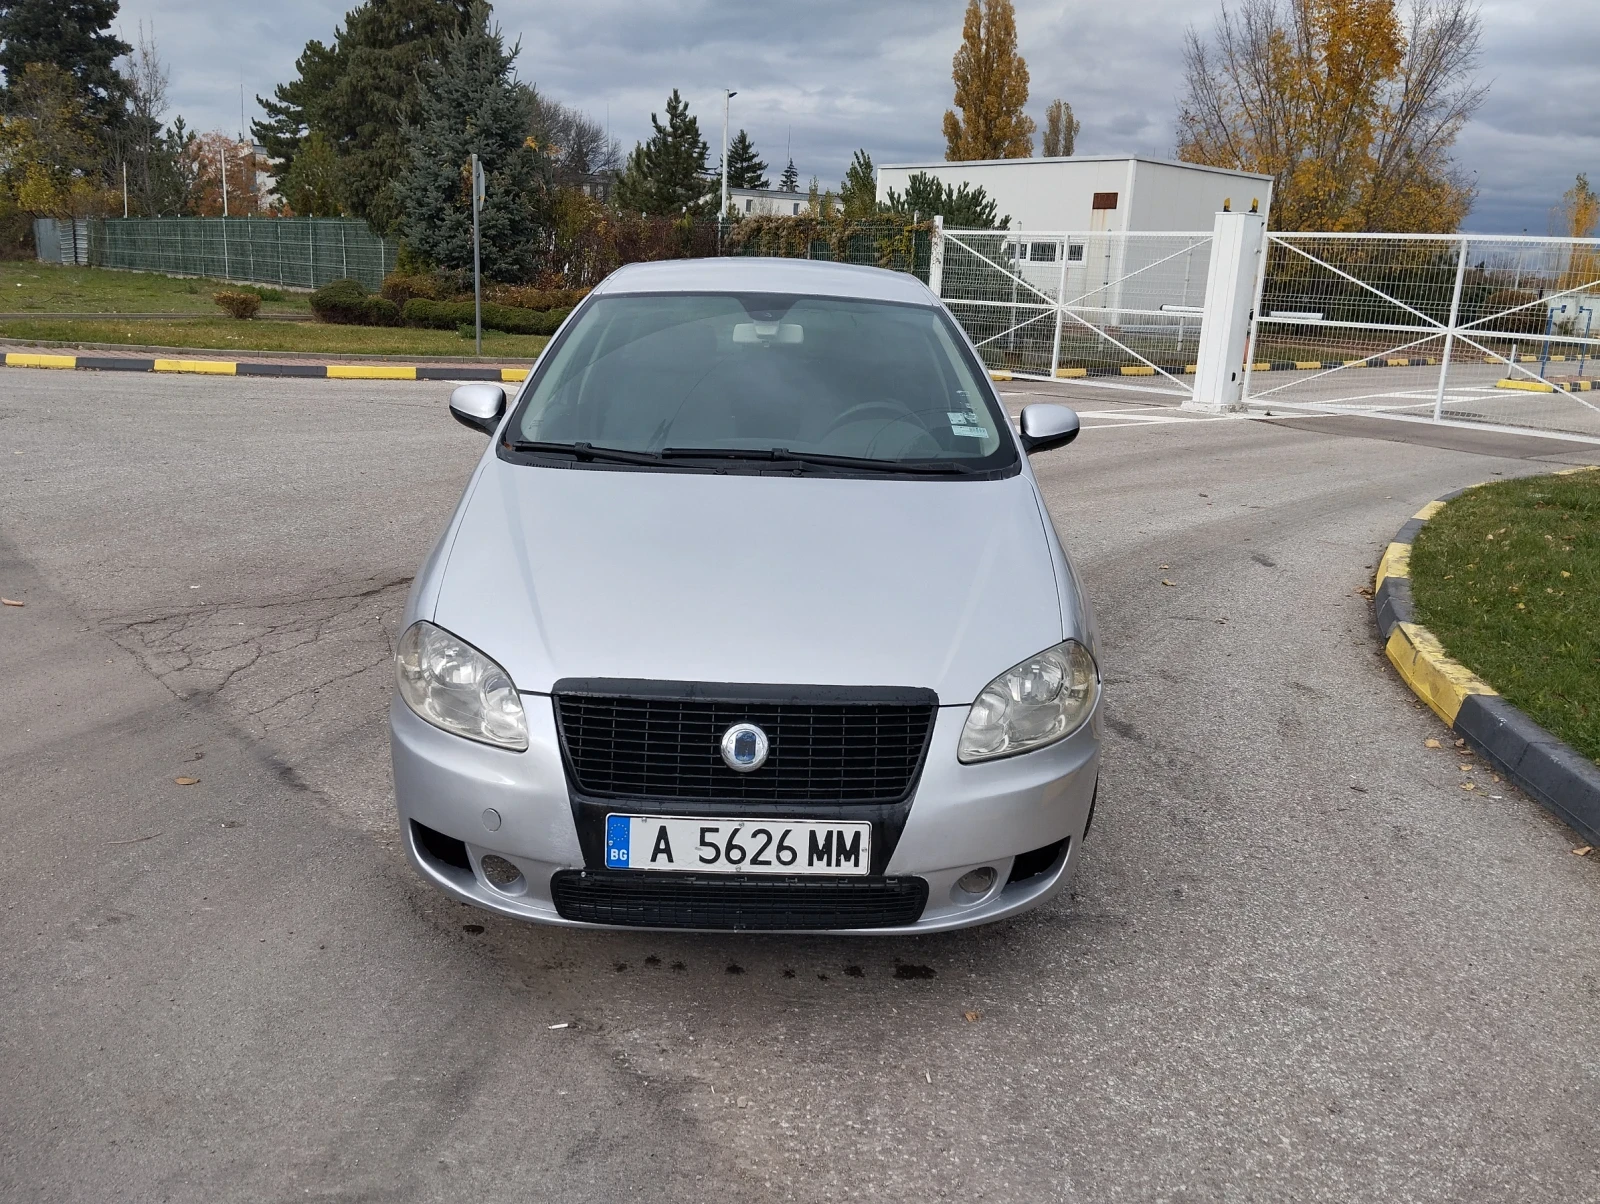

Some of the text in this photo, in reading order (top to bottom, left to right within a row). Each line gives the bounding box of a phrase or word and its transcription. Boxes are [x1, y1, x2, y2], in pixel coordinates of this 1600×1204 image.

[610, 849, 628, 861] BG
[650, 825, 861, 867] A 5626 MM
